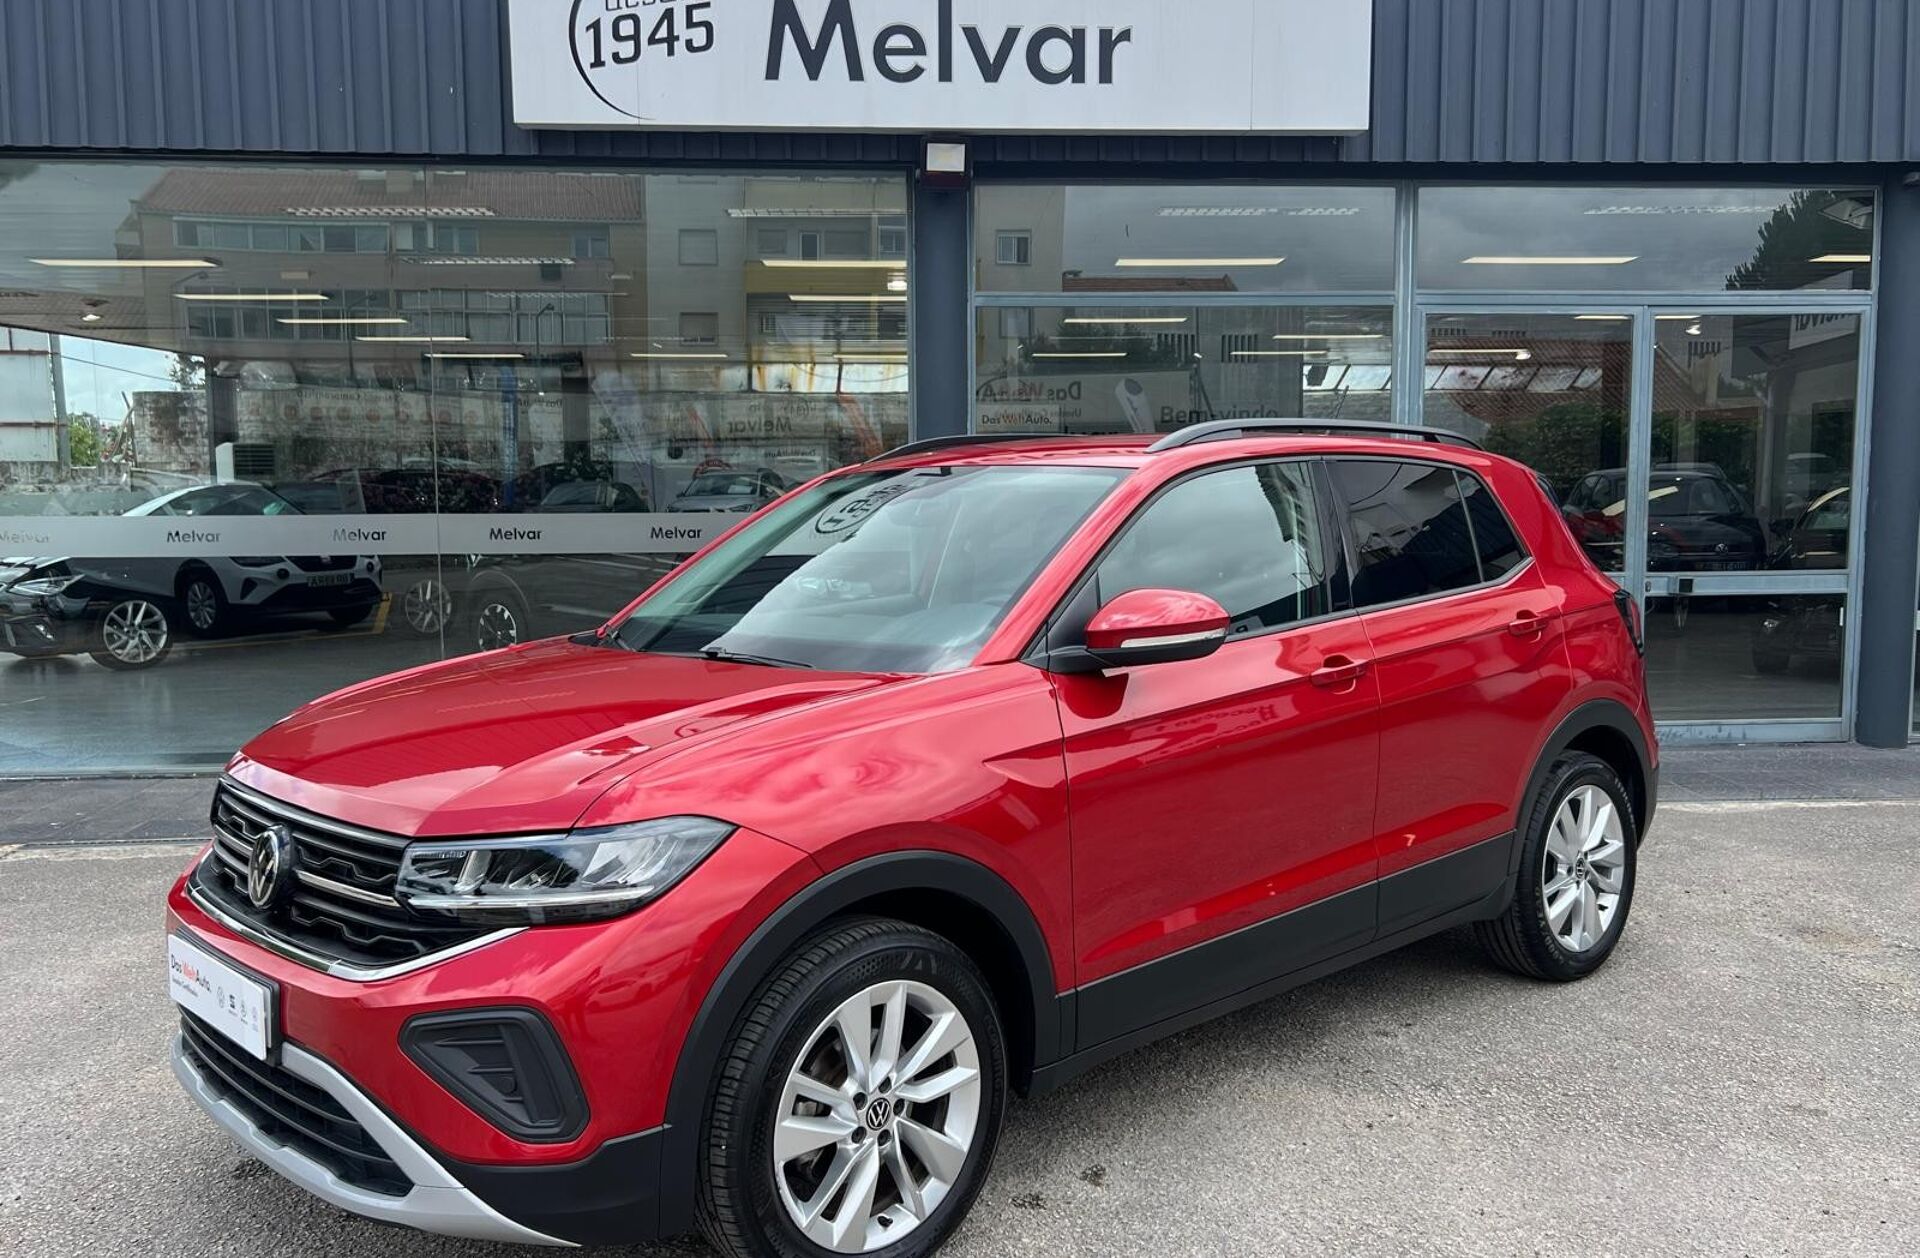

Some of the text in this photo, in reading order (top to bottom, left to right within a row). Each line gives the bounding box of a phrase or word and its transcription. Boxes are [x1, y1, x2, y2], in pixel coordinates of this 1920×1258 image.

[586, 2, 714, 69] 1945
[765, 0, 1132, 85] Melvar
[167, 530, 221, 543] Melvar
[333, 528, 386, 541] Melvar
[489, 527, 542, 540] Melvar
[650, 526, 702, 539] Melvar
